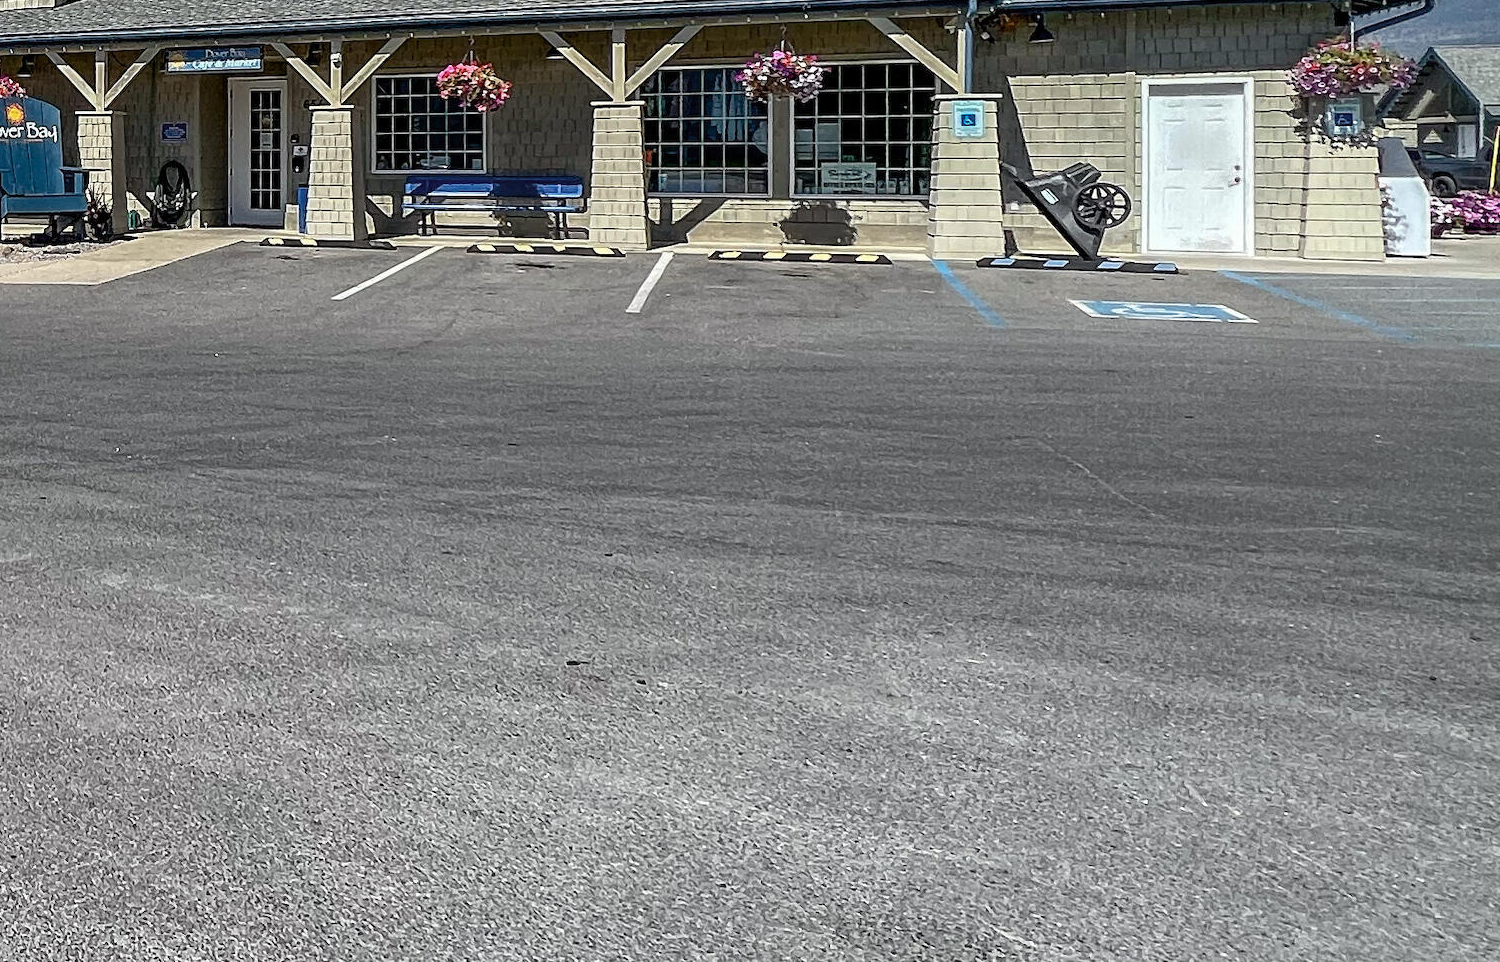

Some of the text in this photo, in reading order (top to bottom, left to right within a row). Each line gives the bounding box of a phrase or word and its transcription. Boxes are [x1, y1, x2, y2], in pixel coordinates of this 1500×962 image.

[205, 48, 246, 59] Dover Bay
[26, 121, 58, 143] Bay
